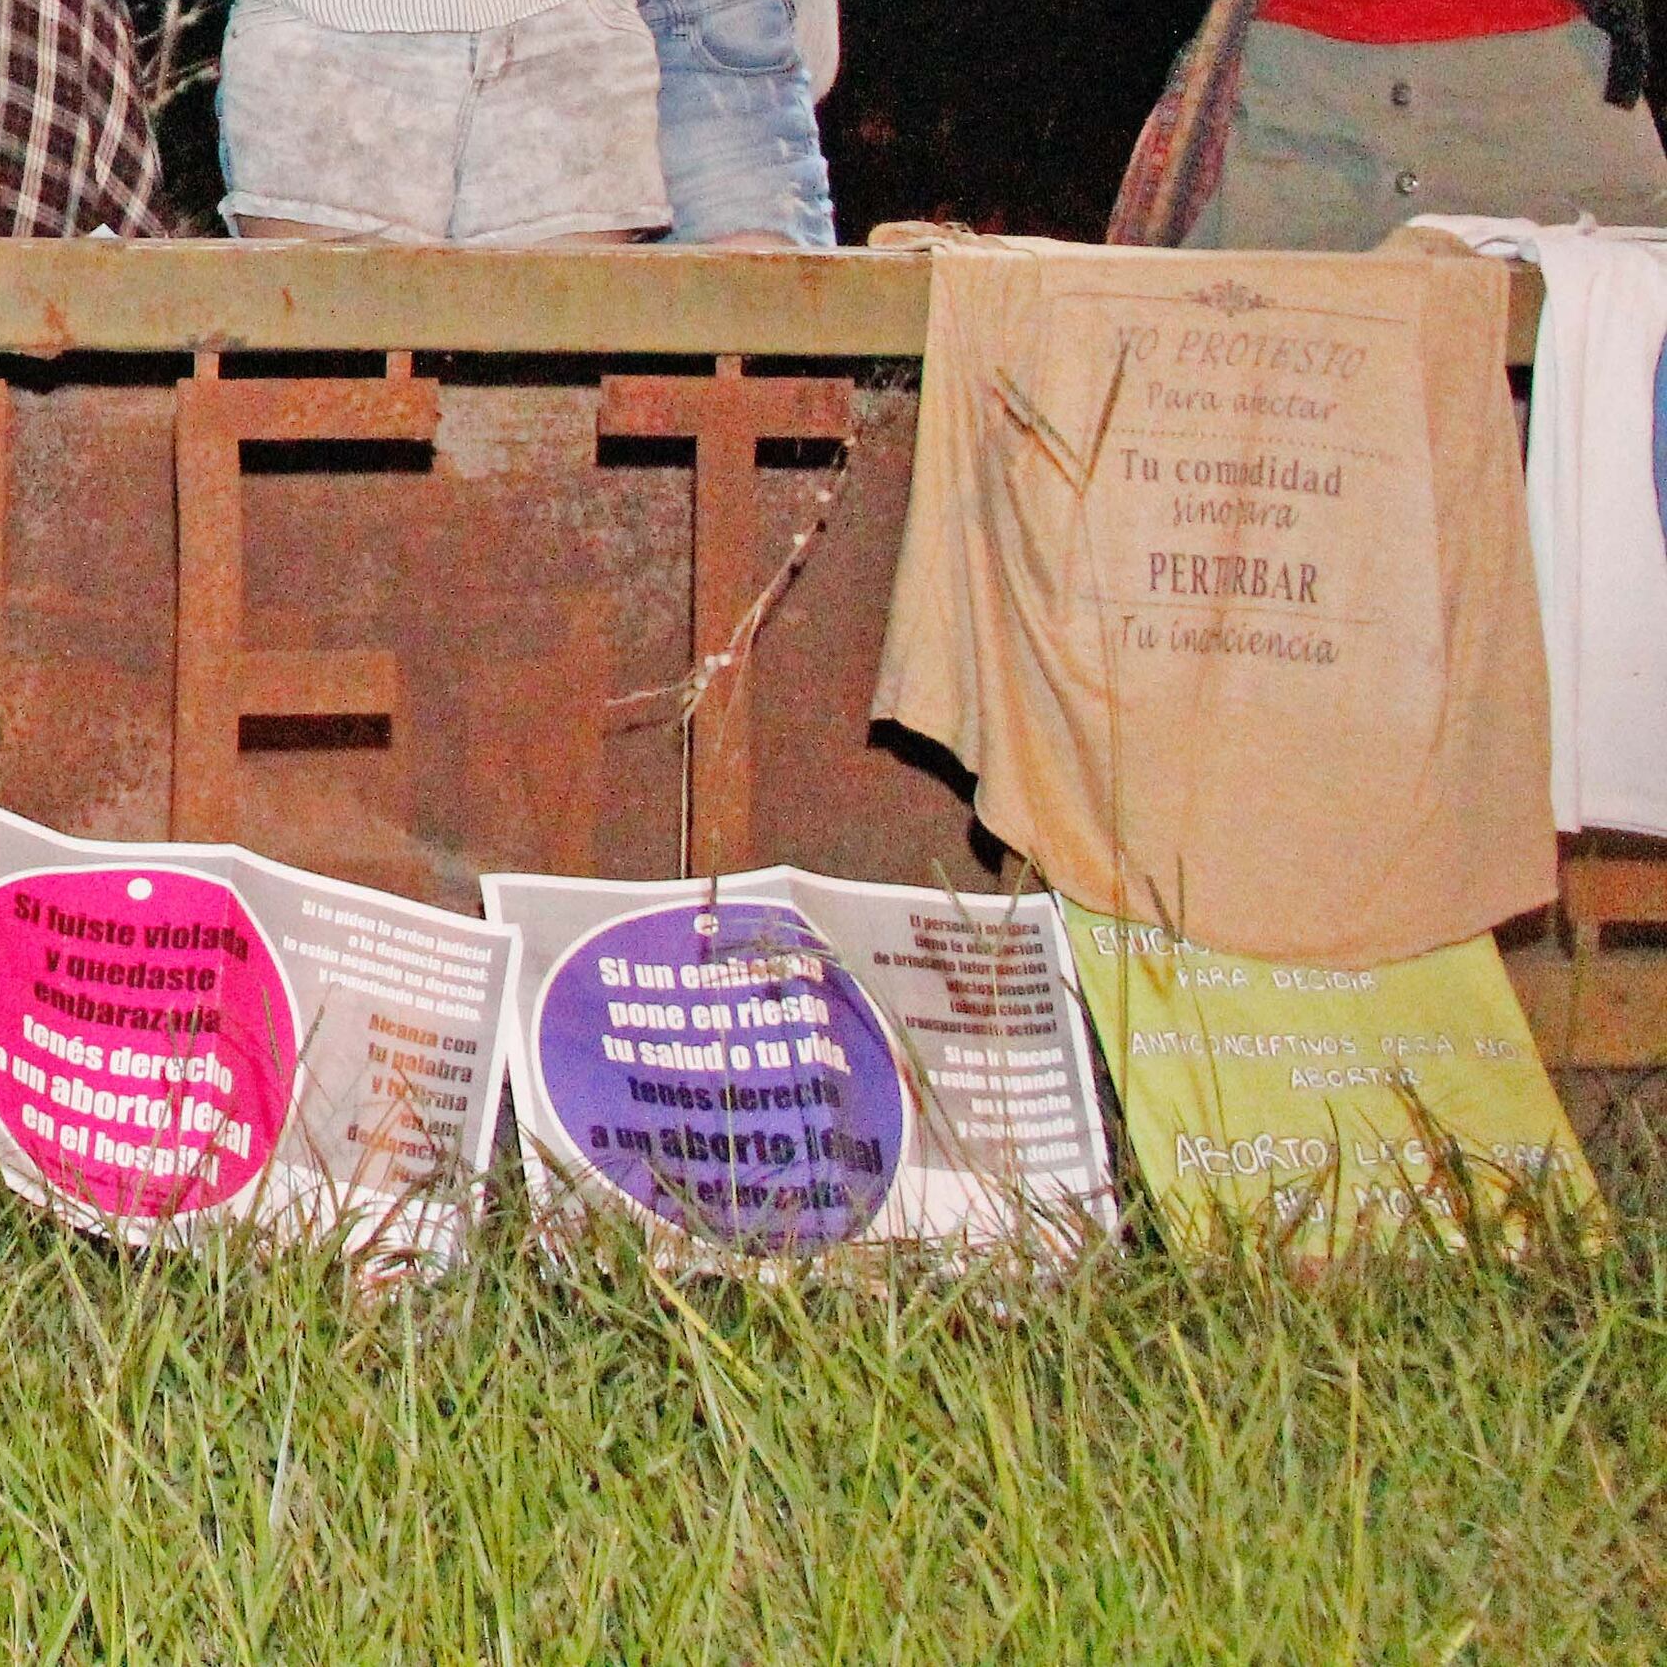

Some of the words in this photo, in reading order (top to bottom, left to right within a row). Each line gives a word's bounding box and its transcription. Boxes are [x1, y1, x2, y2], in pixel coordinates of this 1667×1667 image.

[1177, 328, 1367, 381] PROTESTO
[1147, 380, 1219, 411] Para
[1119, 447, 1159, 482] Tu
[1121, 613, 1155, 649] Tu
[14, 891, 41, 926] Si
[47, 903, 136, 947] fuiste
[143, 921, 250, 964] violada
[45, 946, 61, 972] y
[66, 953, 216, 991] quedaste
[597, 956, 631, 989] Si
[633, 963, 676, 990] un
[33, 980, 221, 1034] embarazada
[607, 1000, 687, 1031] pone
[690, 1003, 734, 1031] en
[736, 993, 831, 1029] riesgo
[21, 1012, 104, 1071] tenés
[108, 1046, 234, 1095] derecho
[442, 1035, 478, 1055] con
[601, 1033, 637, 1063] tu
[637, 1038, 728, 1072] salud
[729, 1043, 752, 1072] o
[754, 1038, 792, 1069] tu
[391, 1048, 473, 1084] palabra
[11, 1054, 47, 1095] un
[49, 1074, 173, 1130] aborto
[627, 1075, 714, 1112] tenés
[21, 1102, 56, 1142] en
[59, 1122, 91, 1157] el
[590, 1124, 610, 1149] a
[659, 1123, 797, 1166] aborto
[1173, 1132, 1329, 1179] ABORTO
